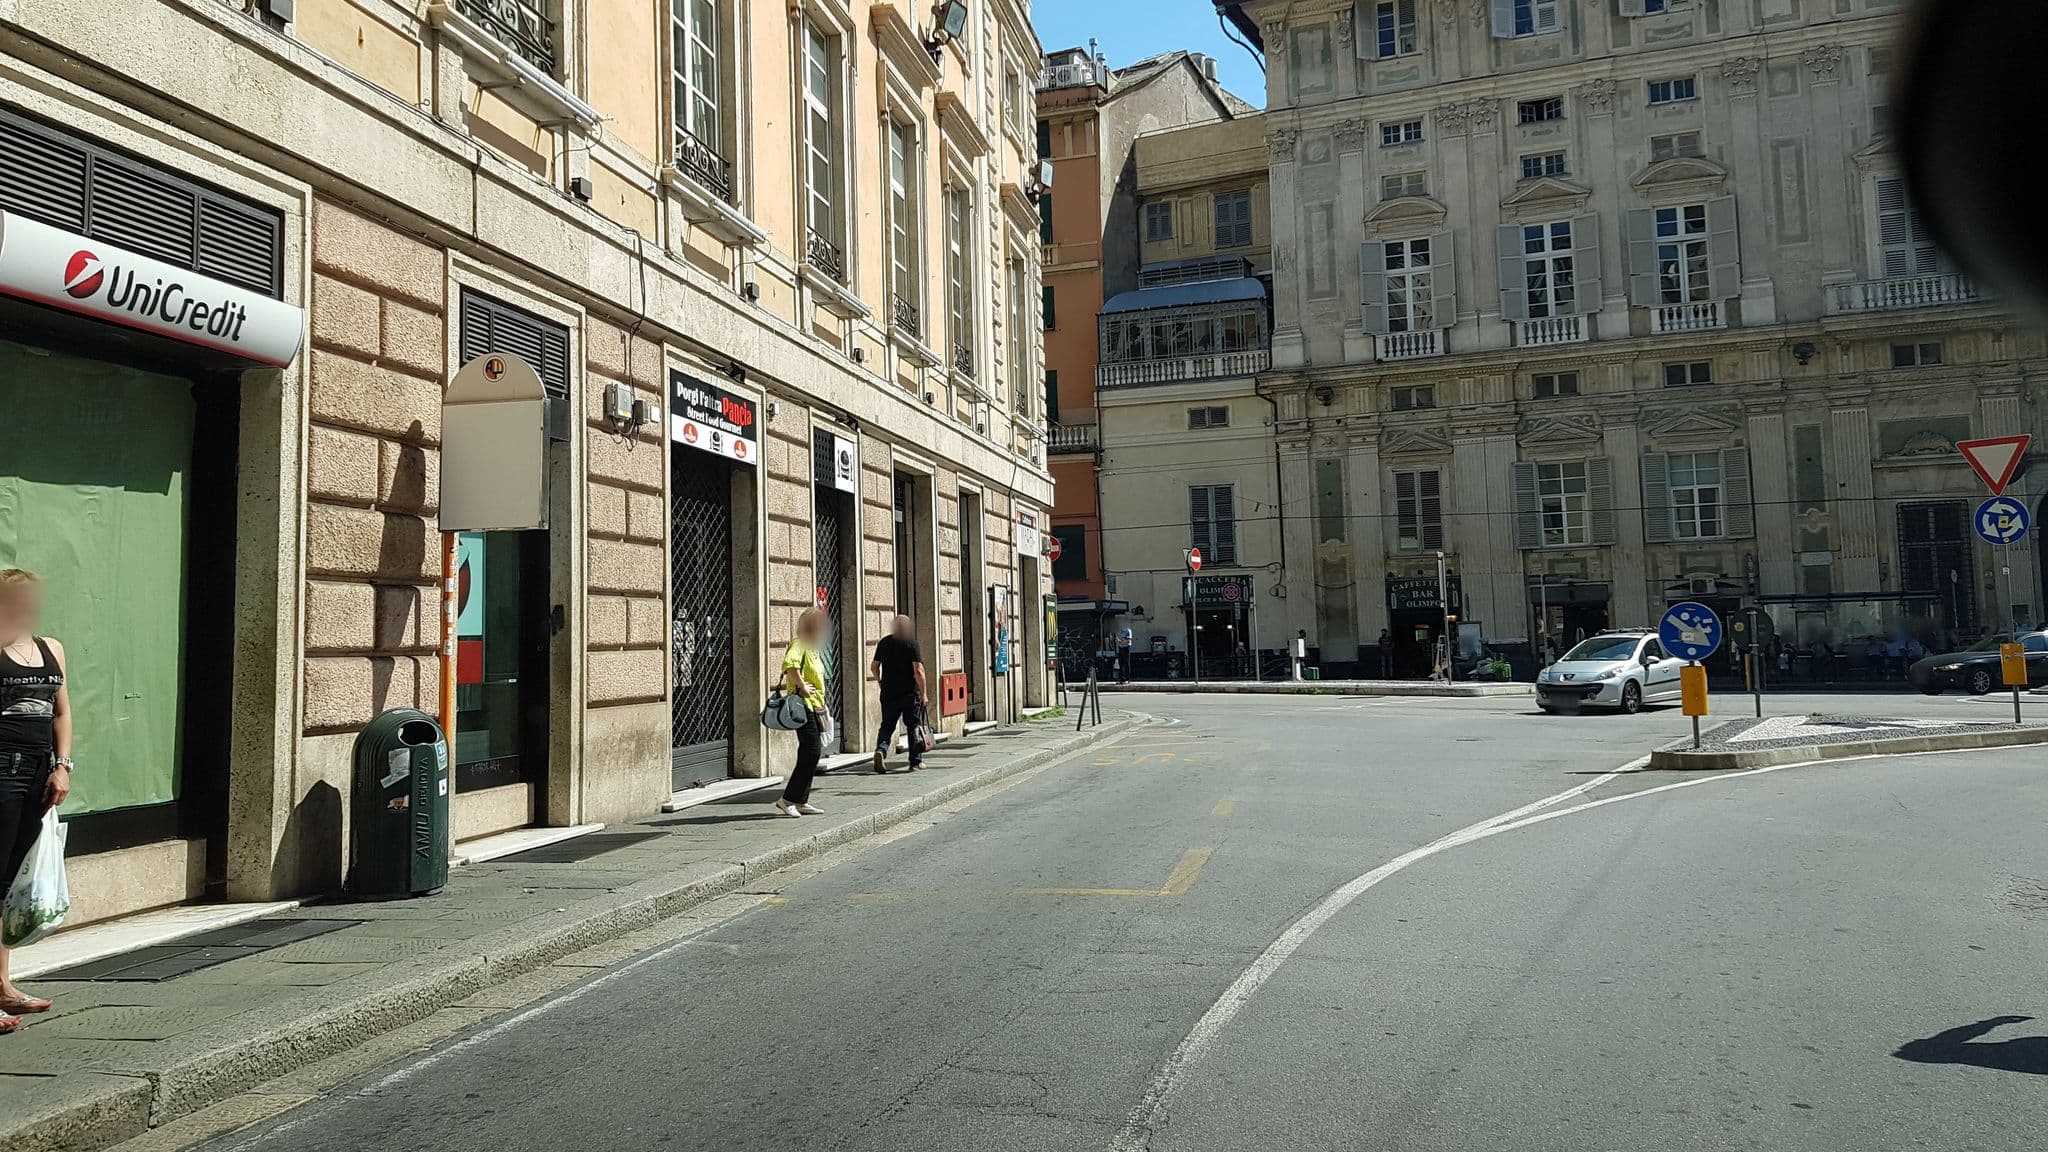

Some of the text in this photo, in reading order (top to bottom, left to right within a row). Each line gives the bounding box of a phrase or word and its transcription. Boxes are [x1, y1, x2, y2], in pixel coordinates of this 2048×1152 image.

[107, 265, 247, 342] UniCredit
[677, 381, 699, 406] Porgi
[722, 396, 752, 426] Pancia
[687, 406, 742, 435] Street Food Gourmet
[1392, 580, 1456, 591] CAFFETTEIA
[1412, 590, 1434, 599] BAR
[1406, 600, 1441, 608] OLIMPO
[416, 755, 430, 859] AMIU GENOVA
